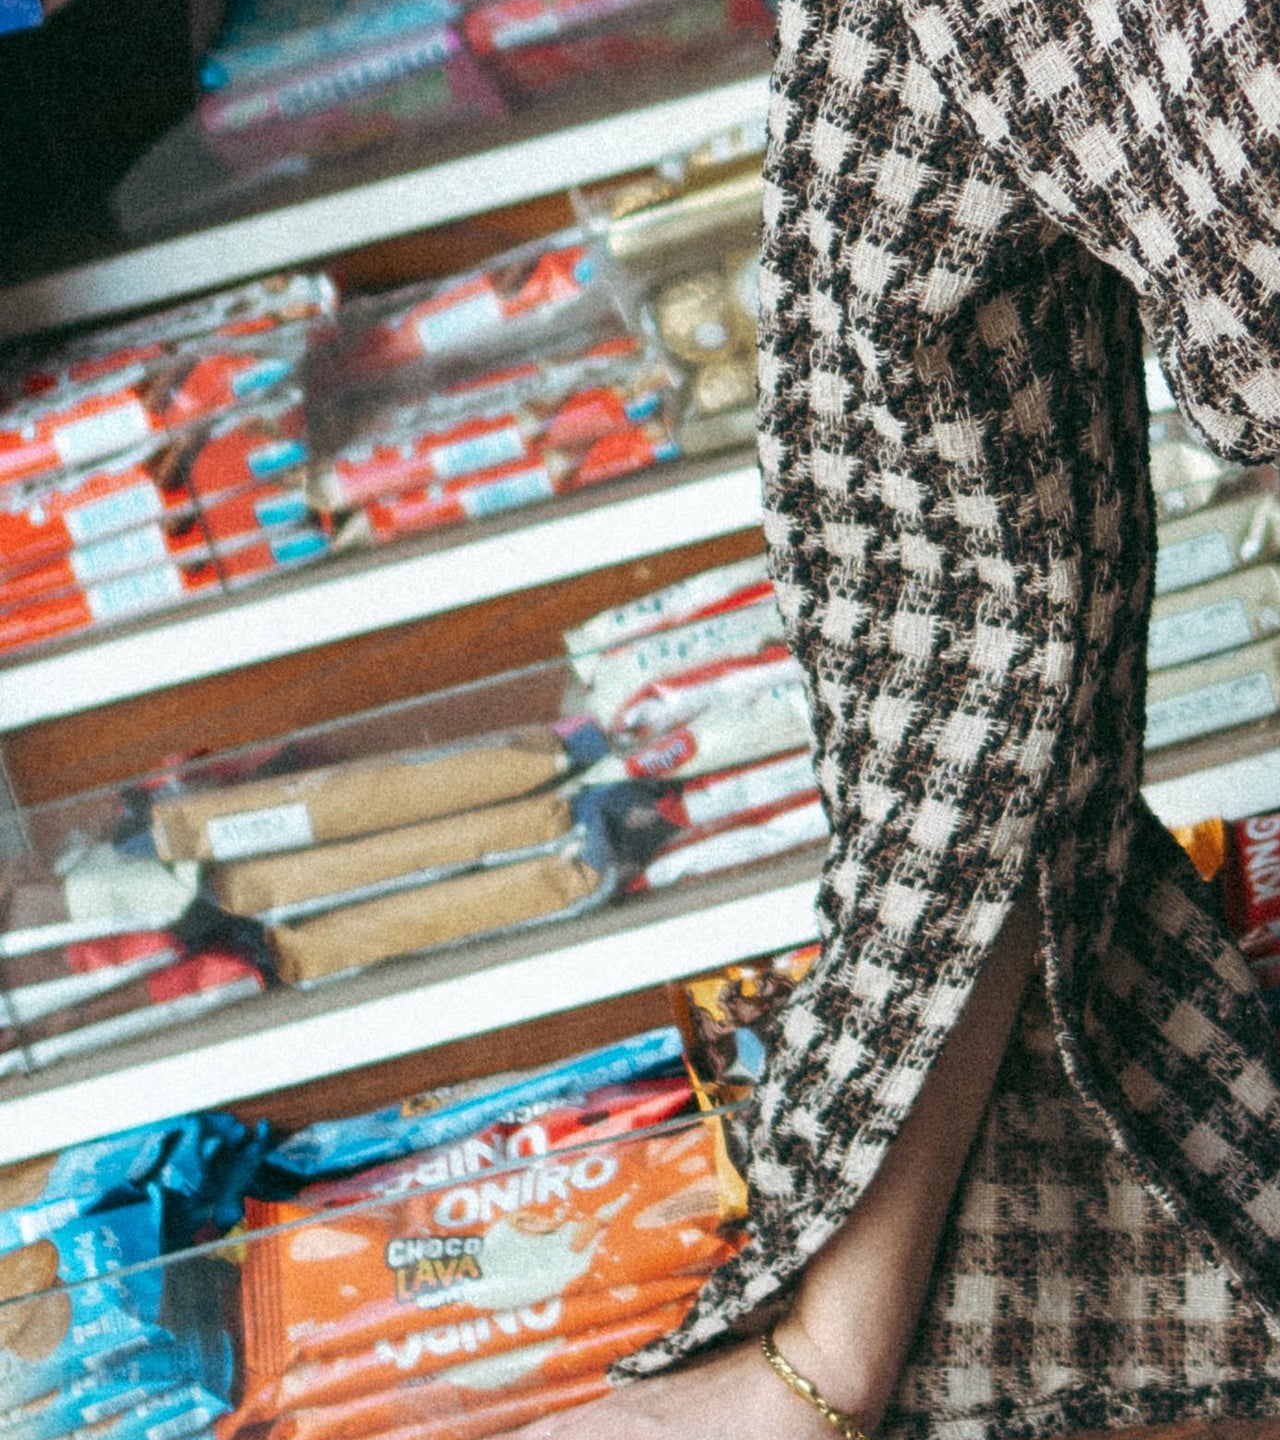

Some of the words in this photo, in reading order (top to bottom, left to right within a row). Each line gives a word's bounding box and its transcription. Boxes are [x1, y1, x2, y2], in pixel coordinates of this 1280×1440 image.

[432, 1154, 618, 1227] ONIRO
[385, 1237, 482, 1267] CHOCO
[397, 1257, 482, 1305] LAVA
